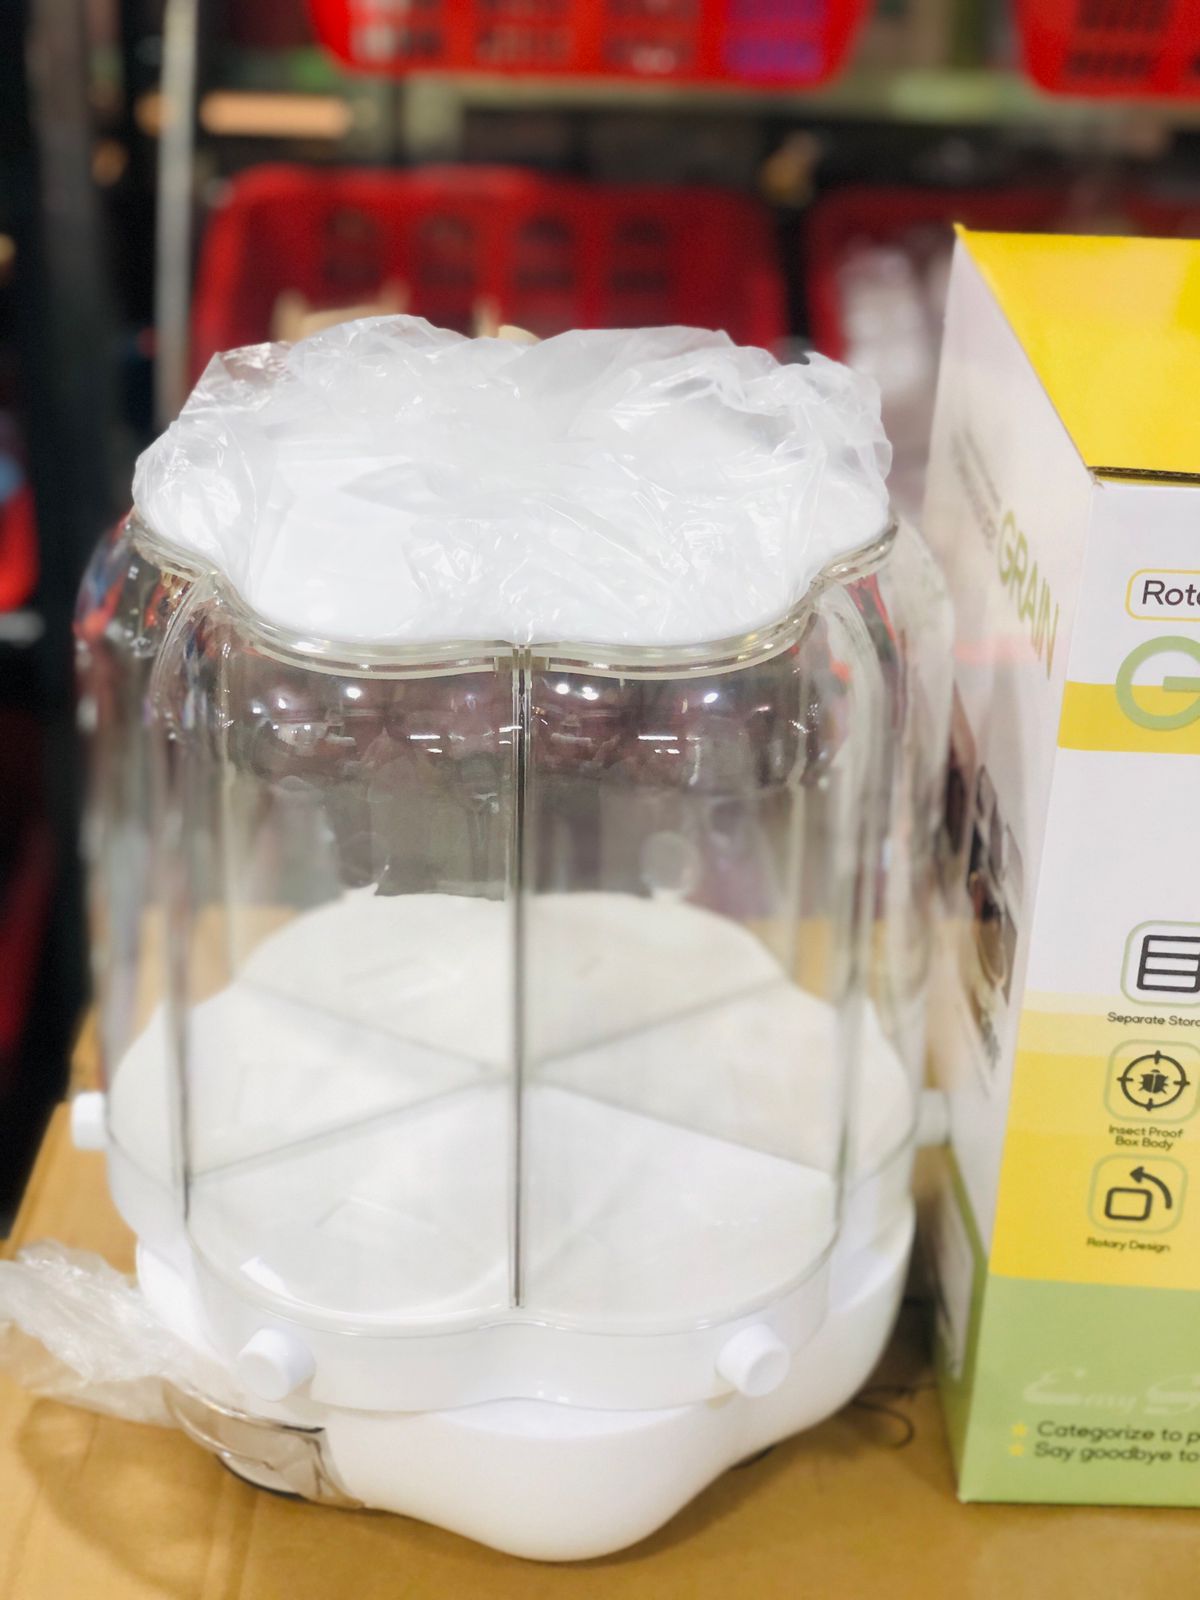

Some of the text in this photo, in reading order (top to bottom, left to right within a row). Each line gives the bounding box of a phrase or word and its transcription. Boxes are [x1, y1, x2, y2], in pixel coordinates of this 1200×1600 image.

[998, 510, 1059, 680] GRAIN
[1142, 580, 1200, 606] Rot
[1107, 1011, 1165, 1026] Separate
[1109, 1125, 1184, 1138] Insect Proof
[1115, 1135, 1173, 1151] Box Body
[1129, 1240, 1170, 1253] Design
[1037, 1420, 1155, 1443] Categorize
[1162, 1429, 1183, 1442] to
[1034, 1440, 1200, 1465] Say goodbye to
